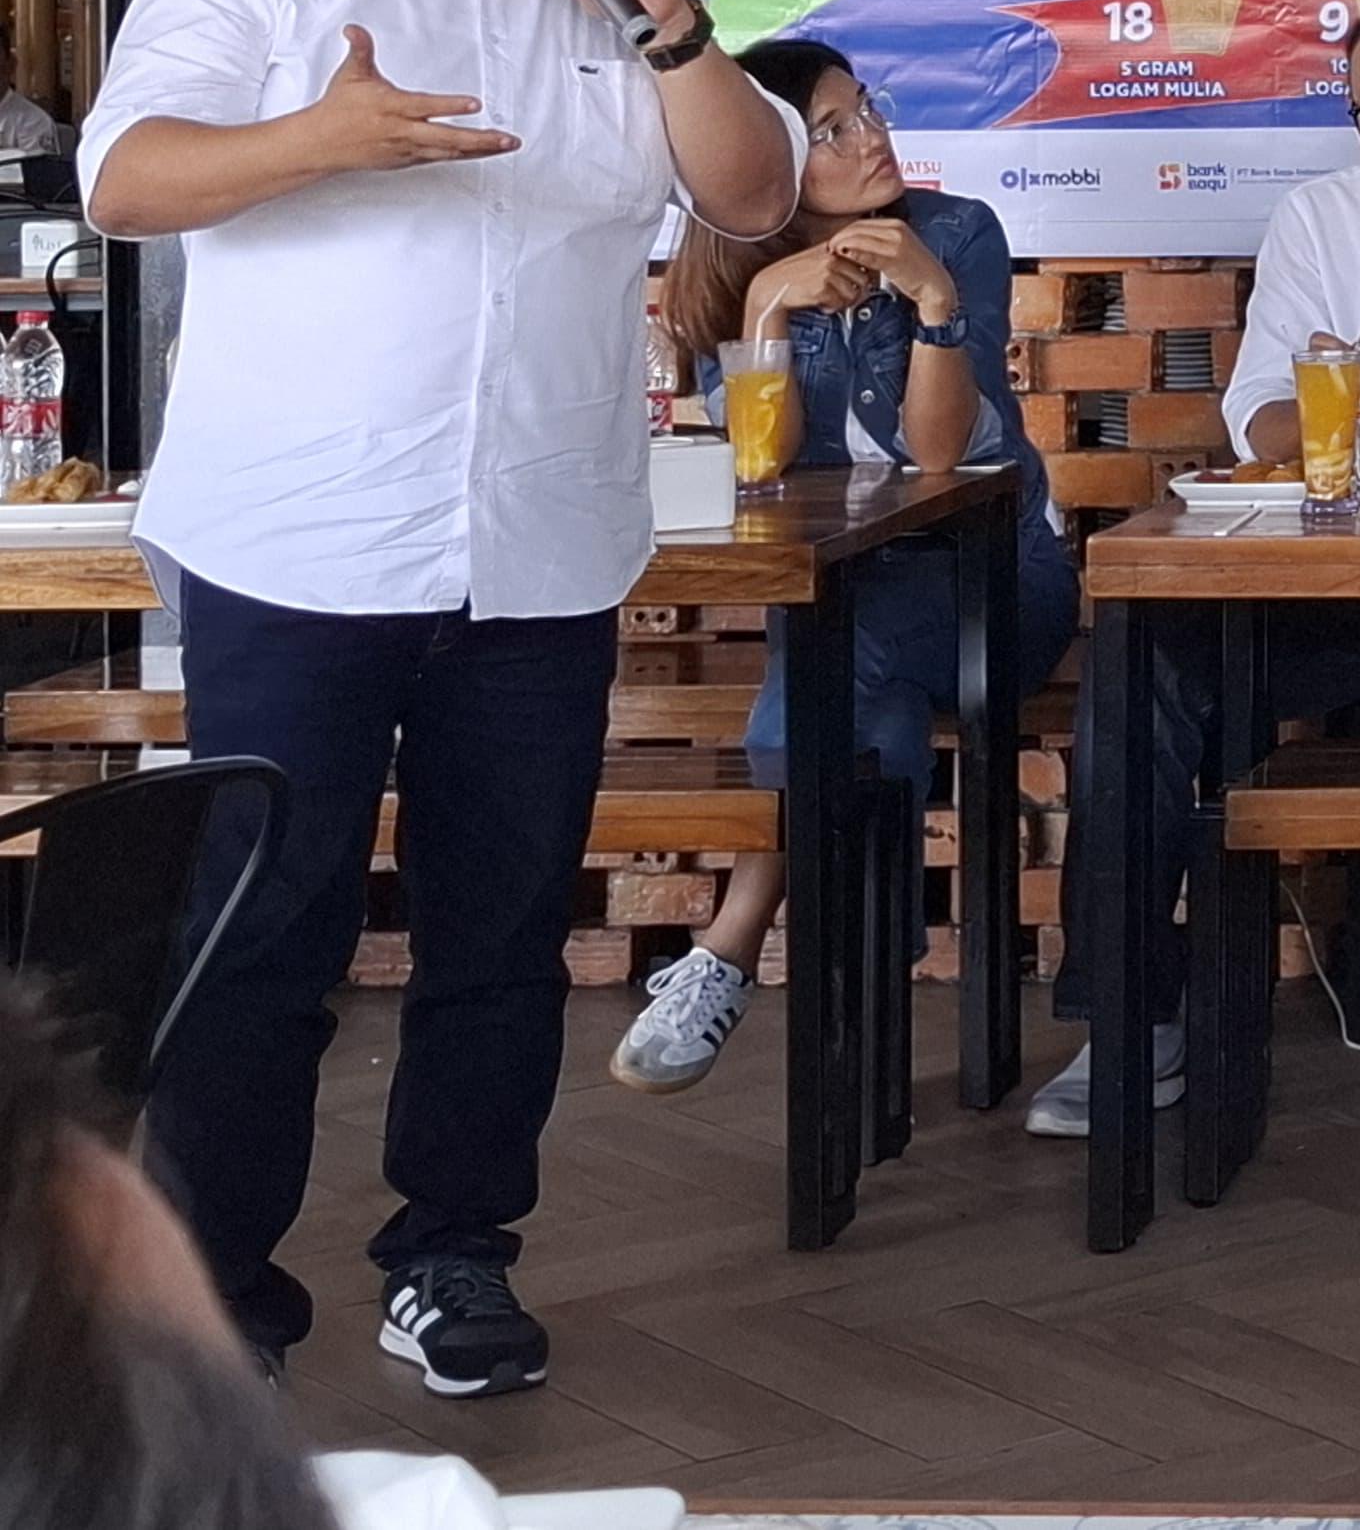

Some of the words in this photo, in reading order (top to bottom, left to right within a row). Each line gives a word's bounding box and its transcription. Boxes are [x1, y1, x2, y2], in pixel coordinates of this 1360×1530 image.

[1102, 1, 1154, 43] 18
[1318, 0, 1349, 43] 9
[1137, 60, 1194, 76] GRAM
[1089, 81, 1160, 98] LOGAM
[1164, 81, 1225, 97] MULIA
[901, 160, 942, 174] ATSU
[1187, 163, 1227, 177] bank
